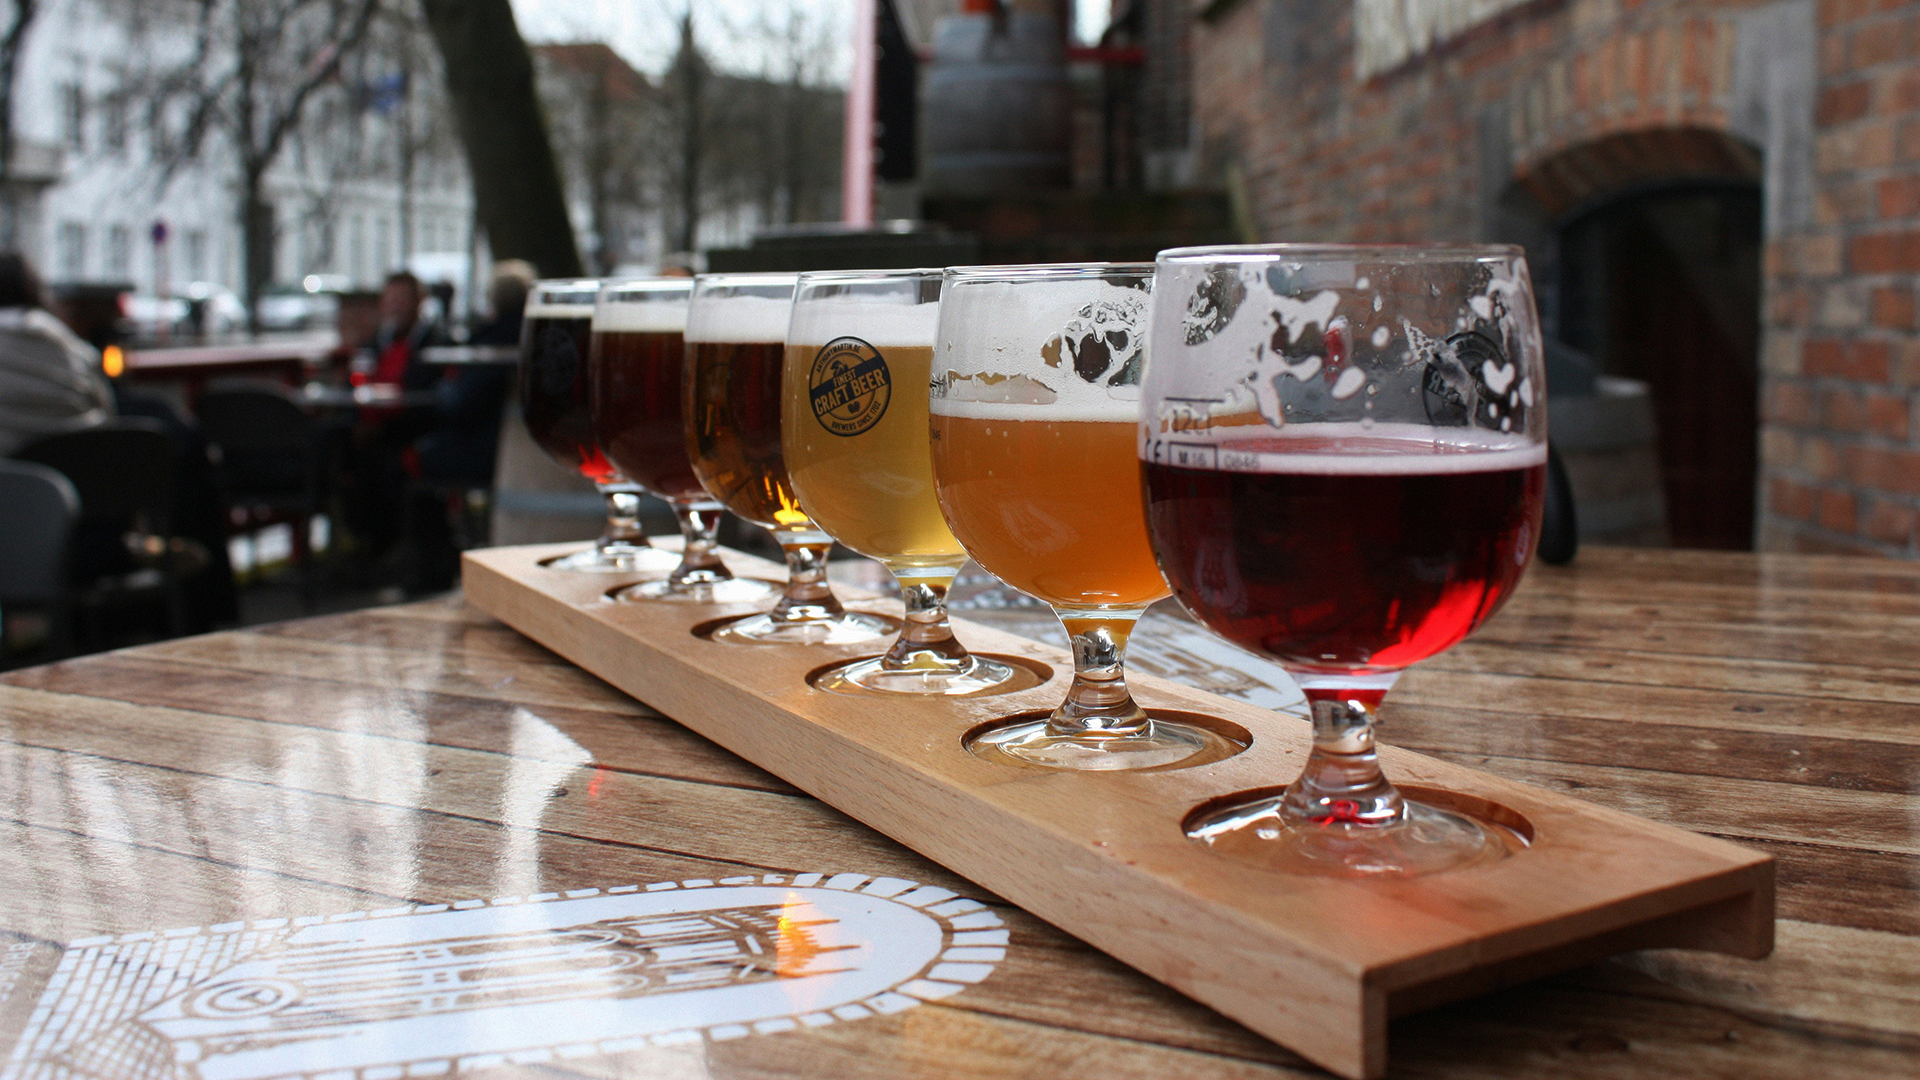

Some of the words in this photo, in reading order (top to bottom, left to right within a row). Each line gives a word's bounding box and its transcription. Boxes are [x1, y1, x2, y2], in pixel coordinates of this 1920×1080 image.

[816, 343, 862, 374] ANTHONYMARTIN.BE
[833, 369, 857, 387] FINEST
[814, 384, 850, 416] CRAFT
[850, 368, 887, 398] BEER
[831, 421, 857, 431] BREWERS
[857, 413, 873, 428] SINCE
